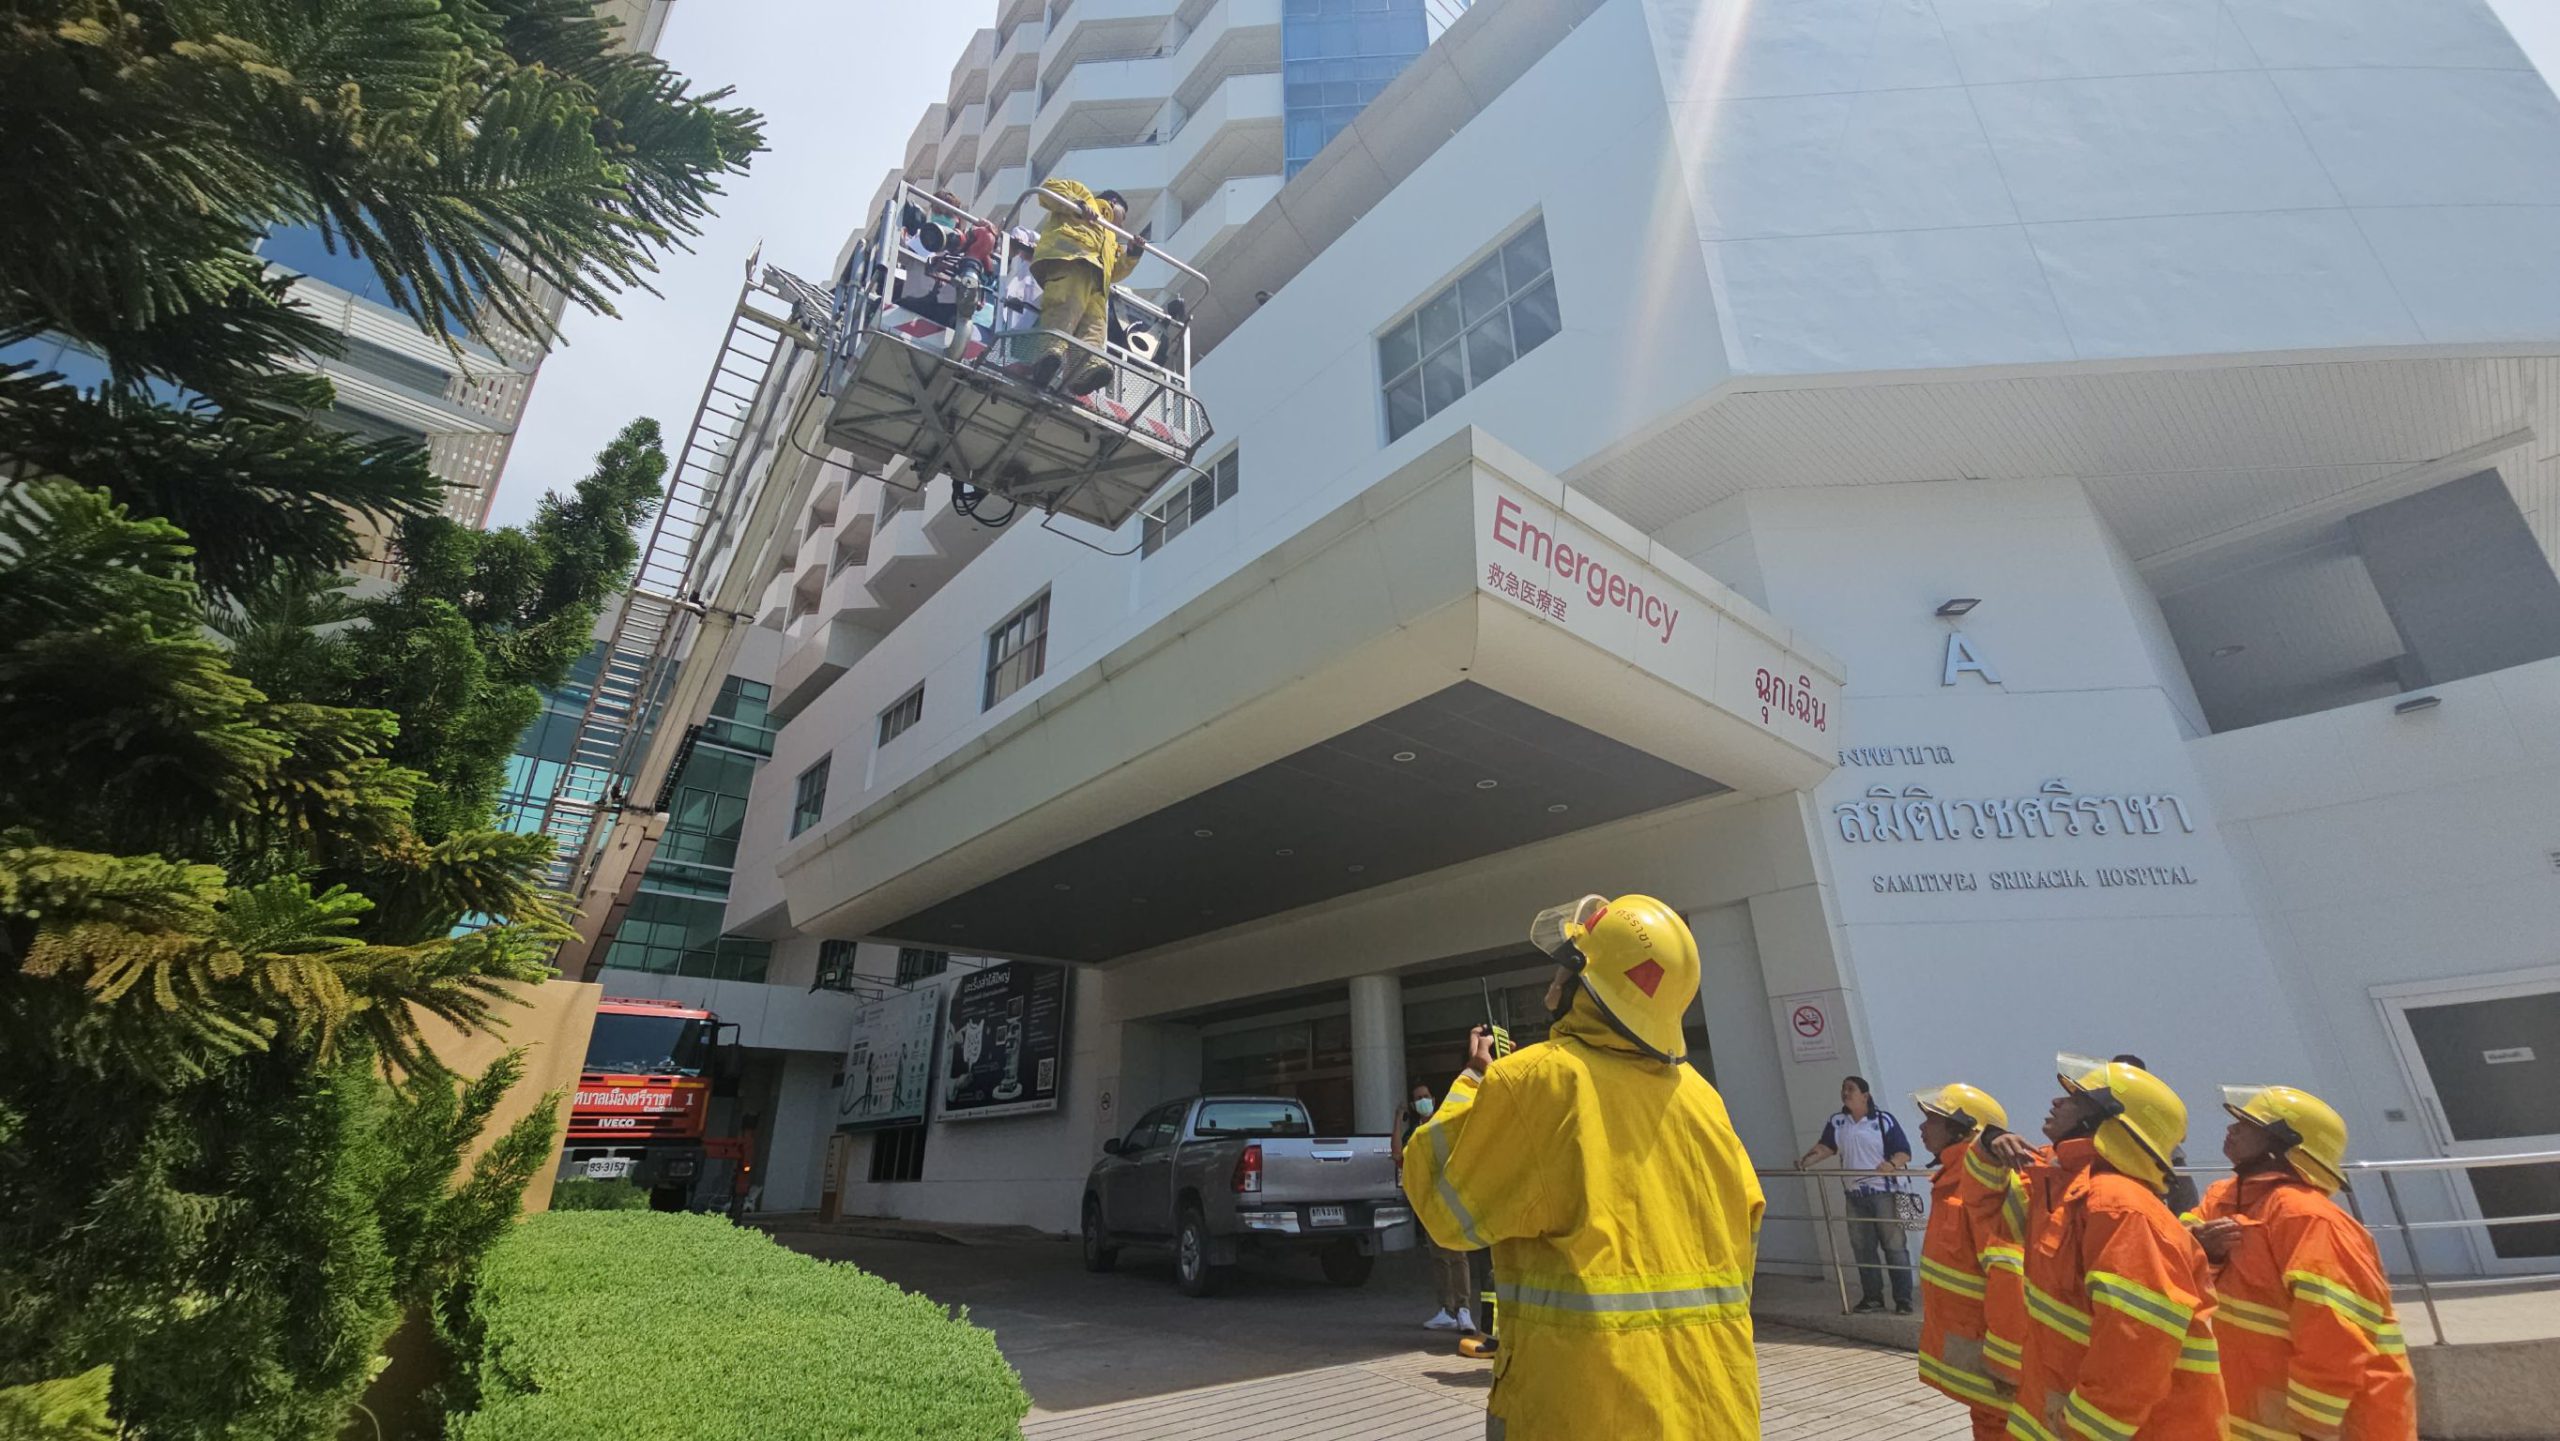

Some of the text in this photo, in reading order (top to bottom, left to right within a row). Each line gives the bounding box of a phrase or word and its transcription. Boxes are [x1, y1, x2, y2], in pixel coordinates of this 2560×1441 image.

[1487, 562, 1567, 623] 救急医療室
[1493, 495, 1678, 643] Emergency
[1941, 631, 2002, 687] A
[1755, 668, 1826, 732] ฉุกเฉิน
[1833, 778, 2194, 842] สมิติเวชศรีราชา
[1872, 865, 2198, 893] SAMITIVEJ SRIRACHA HOSPITAL
[598, 1118, 636, 1127] IVECO
